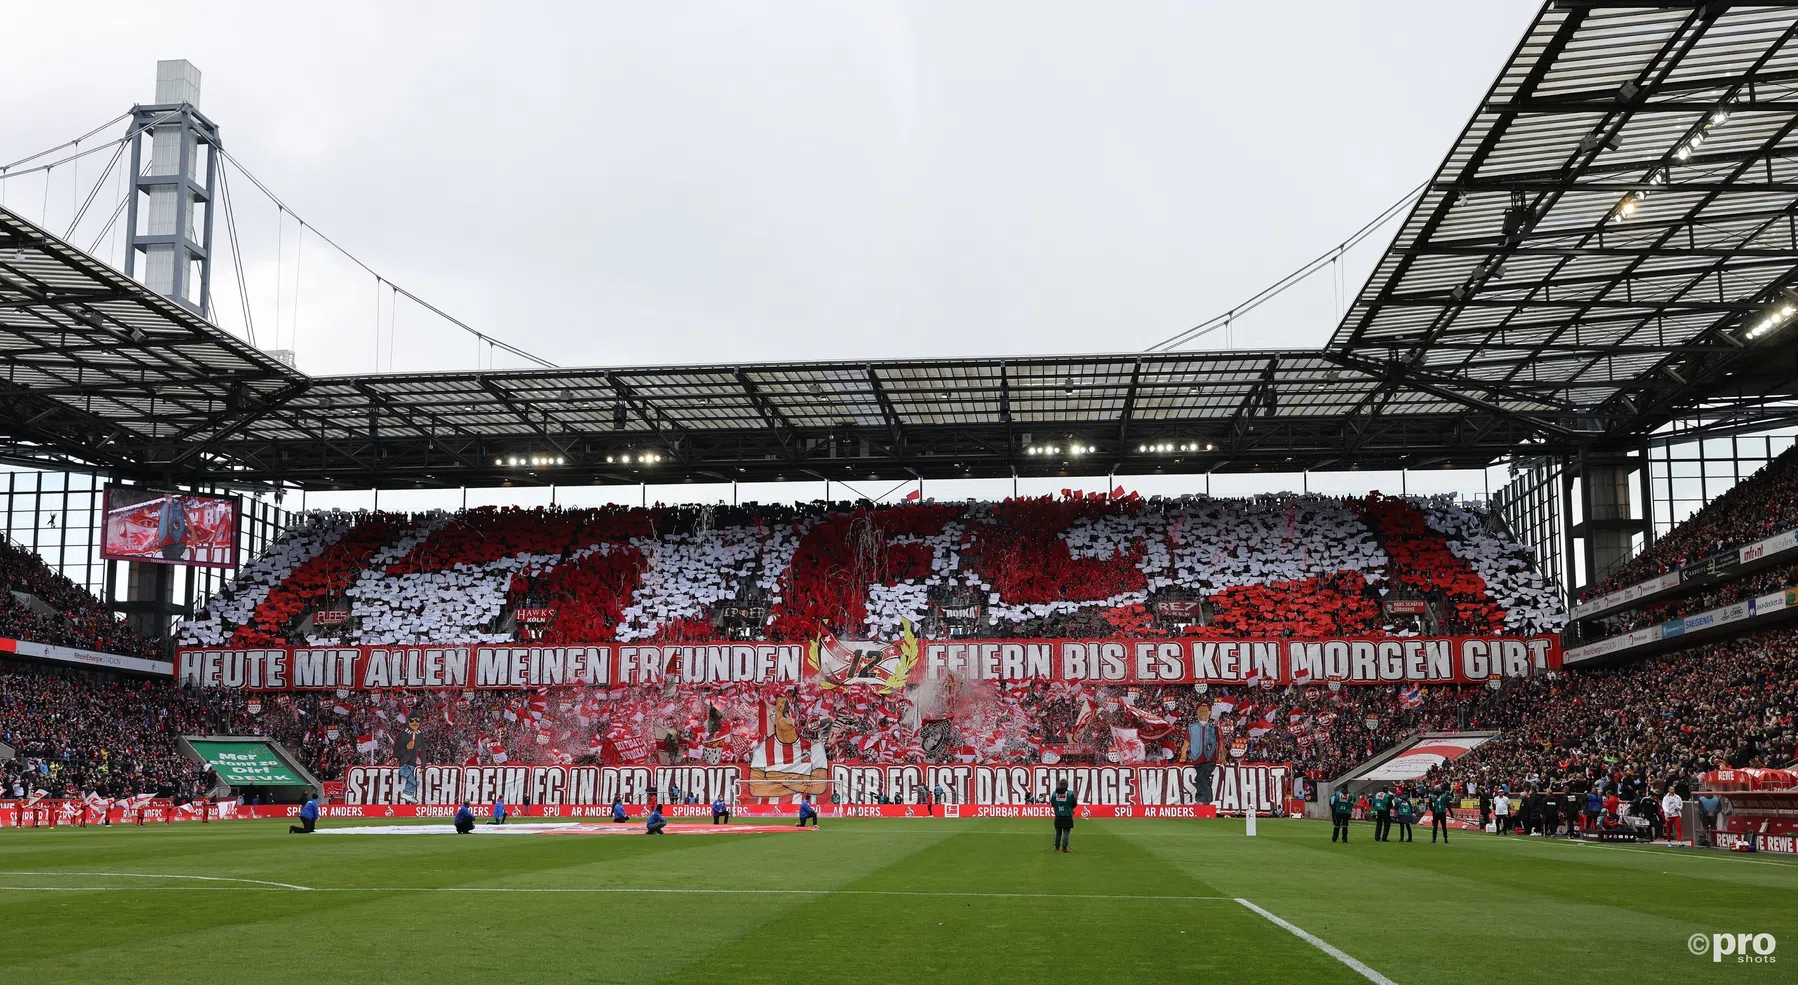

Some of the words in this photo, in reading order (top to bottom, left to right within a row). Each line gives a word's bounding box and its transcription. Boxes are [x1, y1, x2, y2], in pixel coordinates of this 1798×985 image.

[1685, 615, 1714, 629] SIEGENIA
[74, 652, 121, 665] RheinEnergieSTADION
[847, 650, 883, 678] 12
[926, 643, 1053, 681] FEIERN
[1062, 642, 1126, 681] BIS
[1135, 642, 1184, 681] ES
[1191, 641, 1281, 681] KEIN
[1289, 640, 1453, 682] MORGEN
[1461, 639, 1552, 680] GIBT
[180, 649, 287, 688] HEUTE
[294, 649, 360, 688] MIT
[363, 648, 470, 688] ALLEN
[476, 647, 611, 687] MEINEN
[619, 645, 803, 685] FREUNDEN
[218, 752, 257, 761] Mer
[1718, 770, 1735, 780] REWE
[464, 766, 531, 804] BEIM
[532, 766, 567, 804] FC
[569, 766, 598, 804] IN
[601, 766, 653, 804] DER
[655, 766, 742, 804] KURVE
[832, 764, 885, 804] DER
[887, 765, 923, 804] FC
[926, 765, 973, 804] IST
[975, 766, 1030, 804] DAS
[1034, 766, 1135, 805] EINZIGE
[1138, 766, 1198, 805] WAS
[330, 806, 365, 817] ANDERS.
[416, 805, 454, 817] SPÜRBAR
[672, 805, 712, 817] SPÜRBAR
[978, 805, 1018, 817] SPÜRBAR
[1159, 806, 1197, 817] ANDERS.
[1716, 833, 1738, 848] REWE
[1767, 834, 1794, 852] REWE
